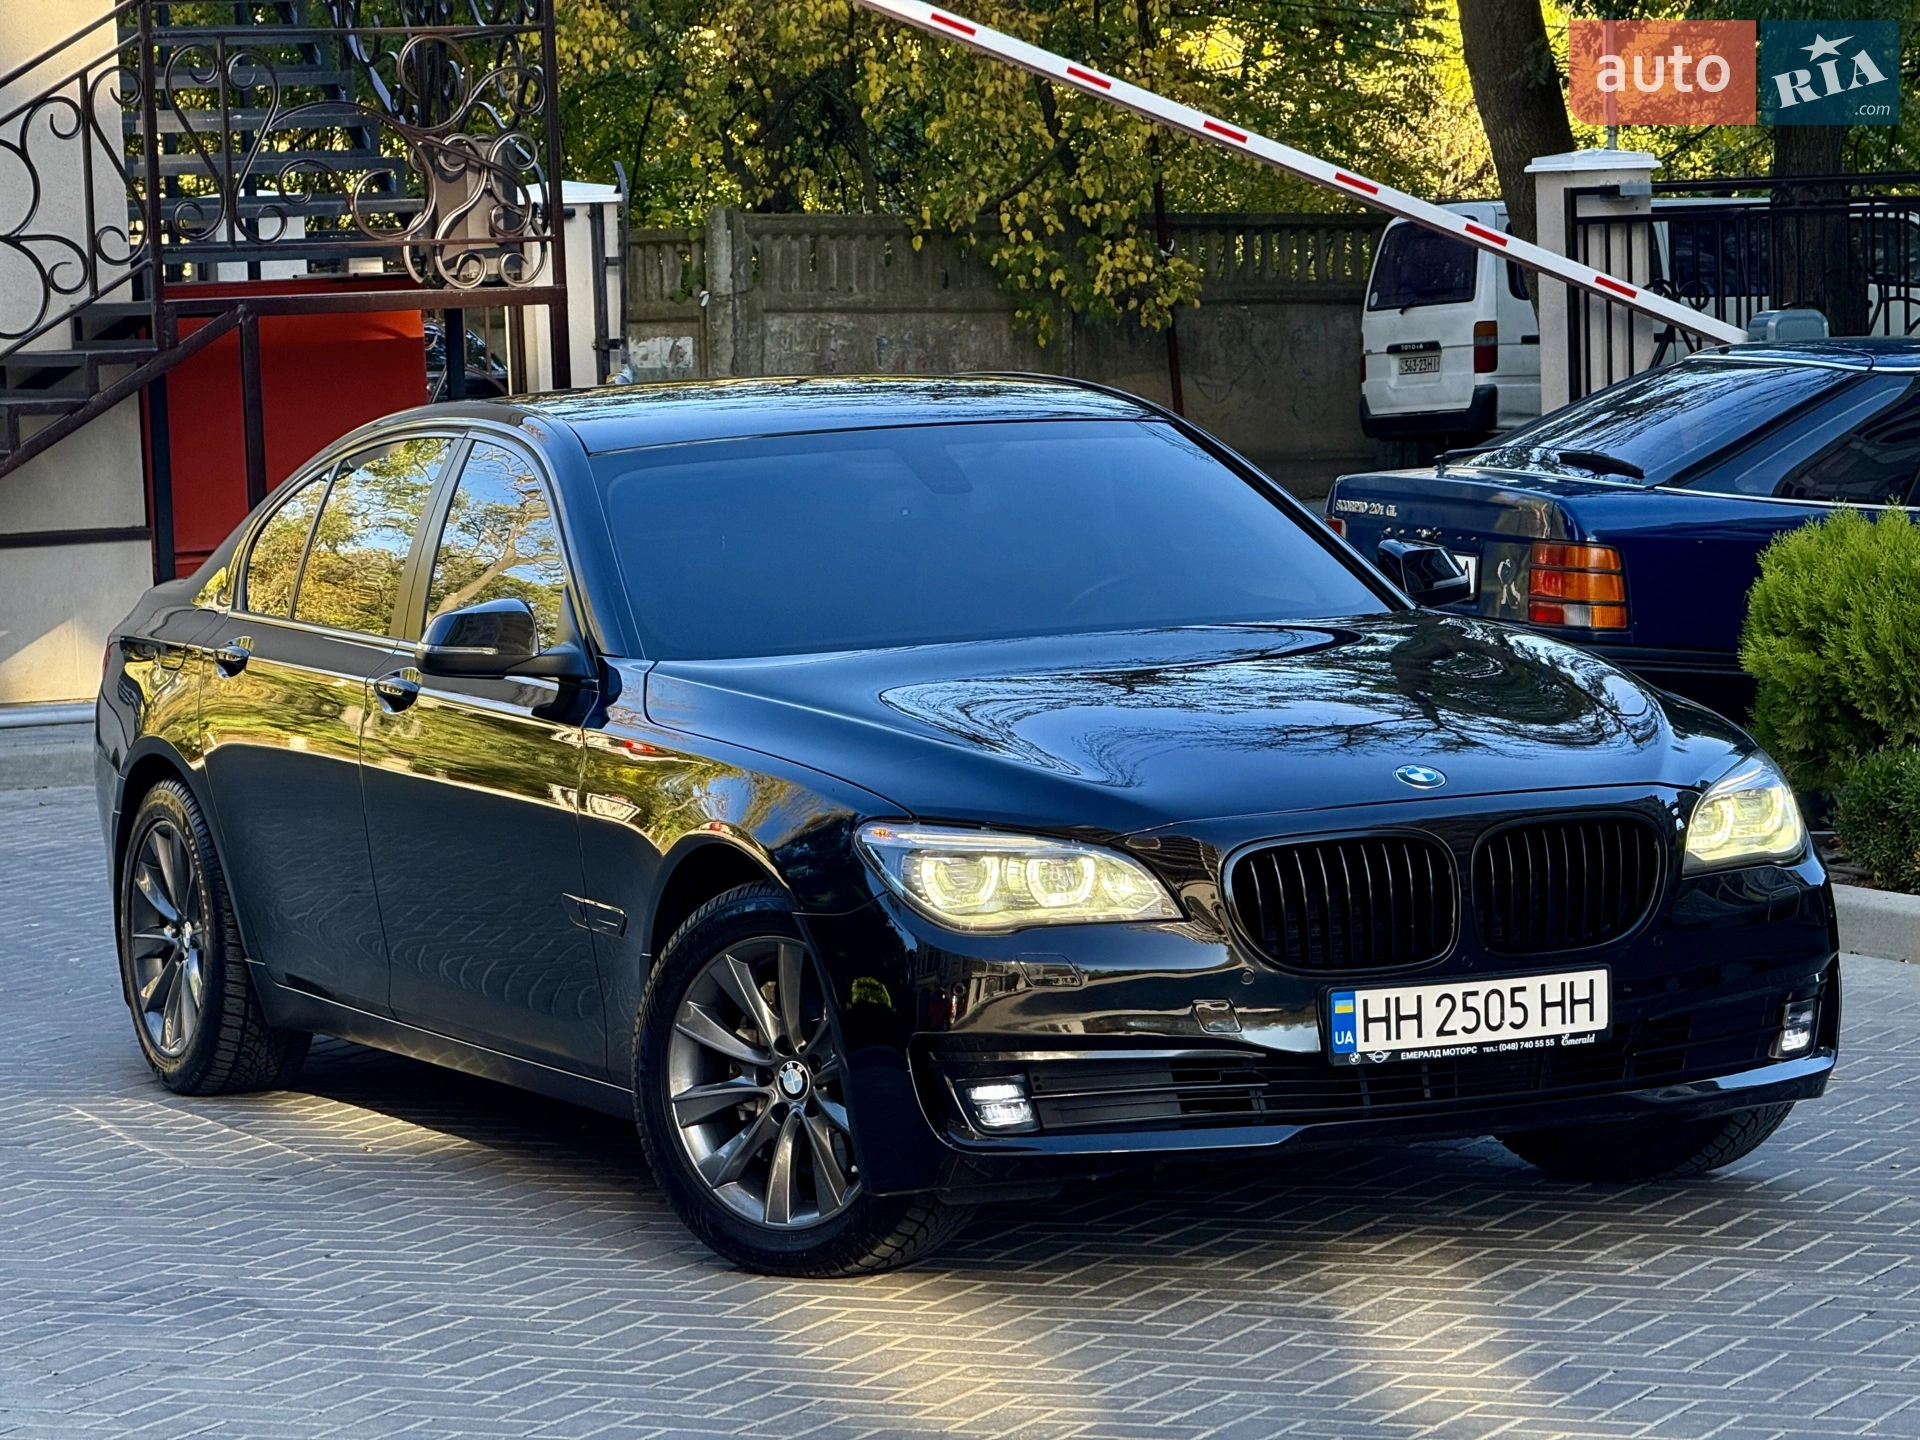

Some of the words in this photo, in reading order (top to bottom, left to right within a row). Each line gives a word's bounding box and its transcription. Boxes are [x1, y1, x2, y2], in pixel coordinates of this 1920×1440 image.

[1335, 499, 1368, 513] SCORPIO
[1386, 504, 1398, 517] GL
[1362, 994, 1423, 1042] HH
[1434, 986, 1529, 1038] 2505
[1540, 978, 1595, 1027] HH
[1334, 1030, 1355, 1045] UA
[1561, 1033, 1596, 1046] Emerald
[1401, 1049, 1442, 1060] ЕМЕРАЛД
[1442, 1046, 1478, 1056] МОТОРС
[1499, 1042, 1519, 1052] (048)
[1520, 1040, 1534, 1050] 740
[1534, 1039, 1545, 1048] 55
[1545, 1038, 1555, 1047] 55
